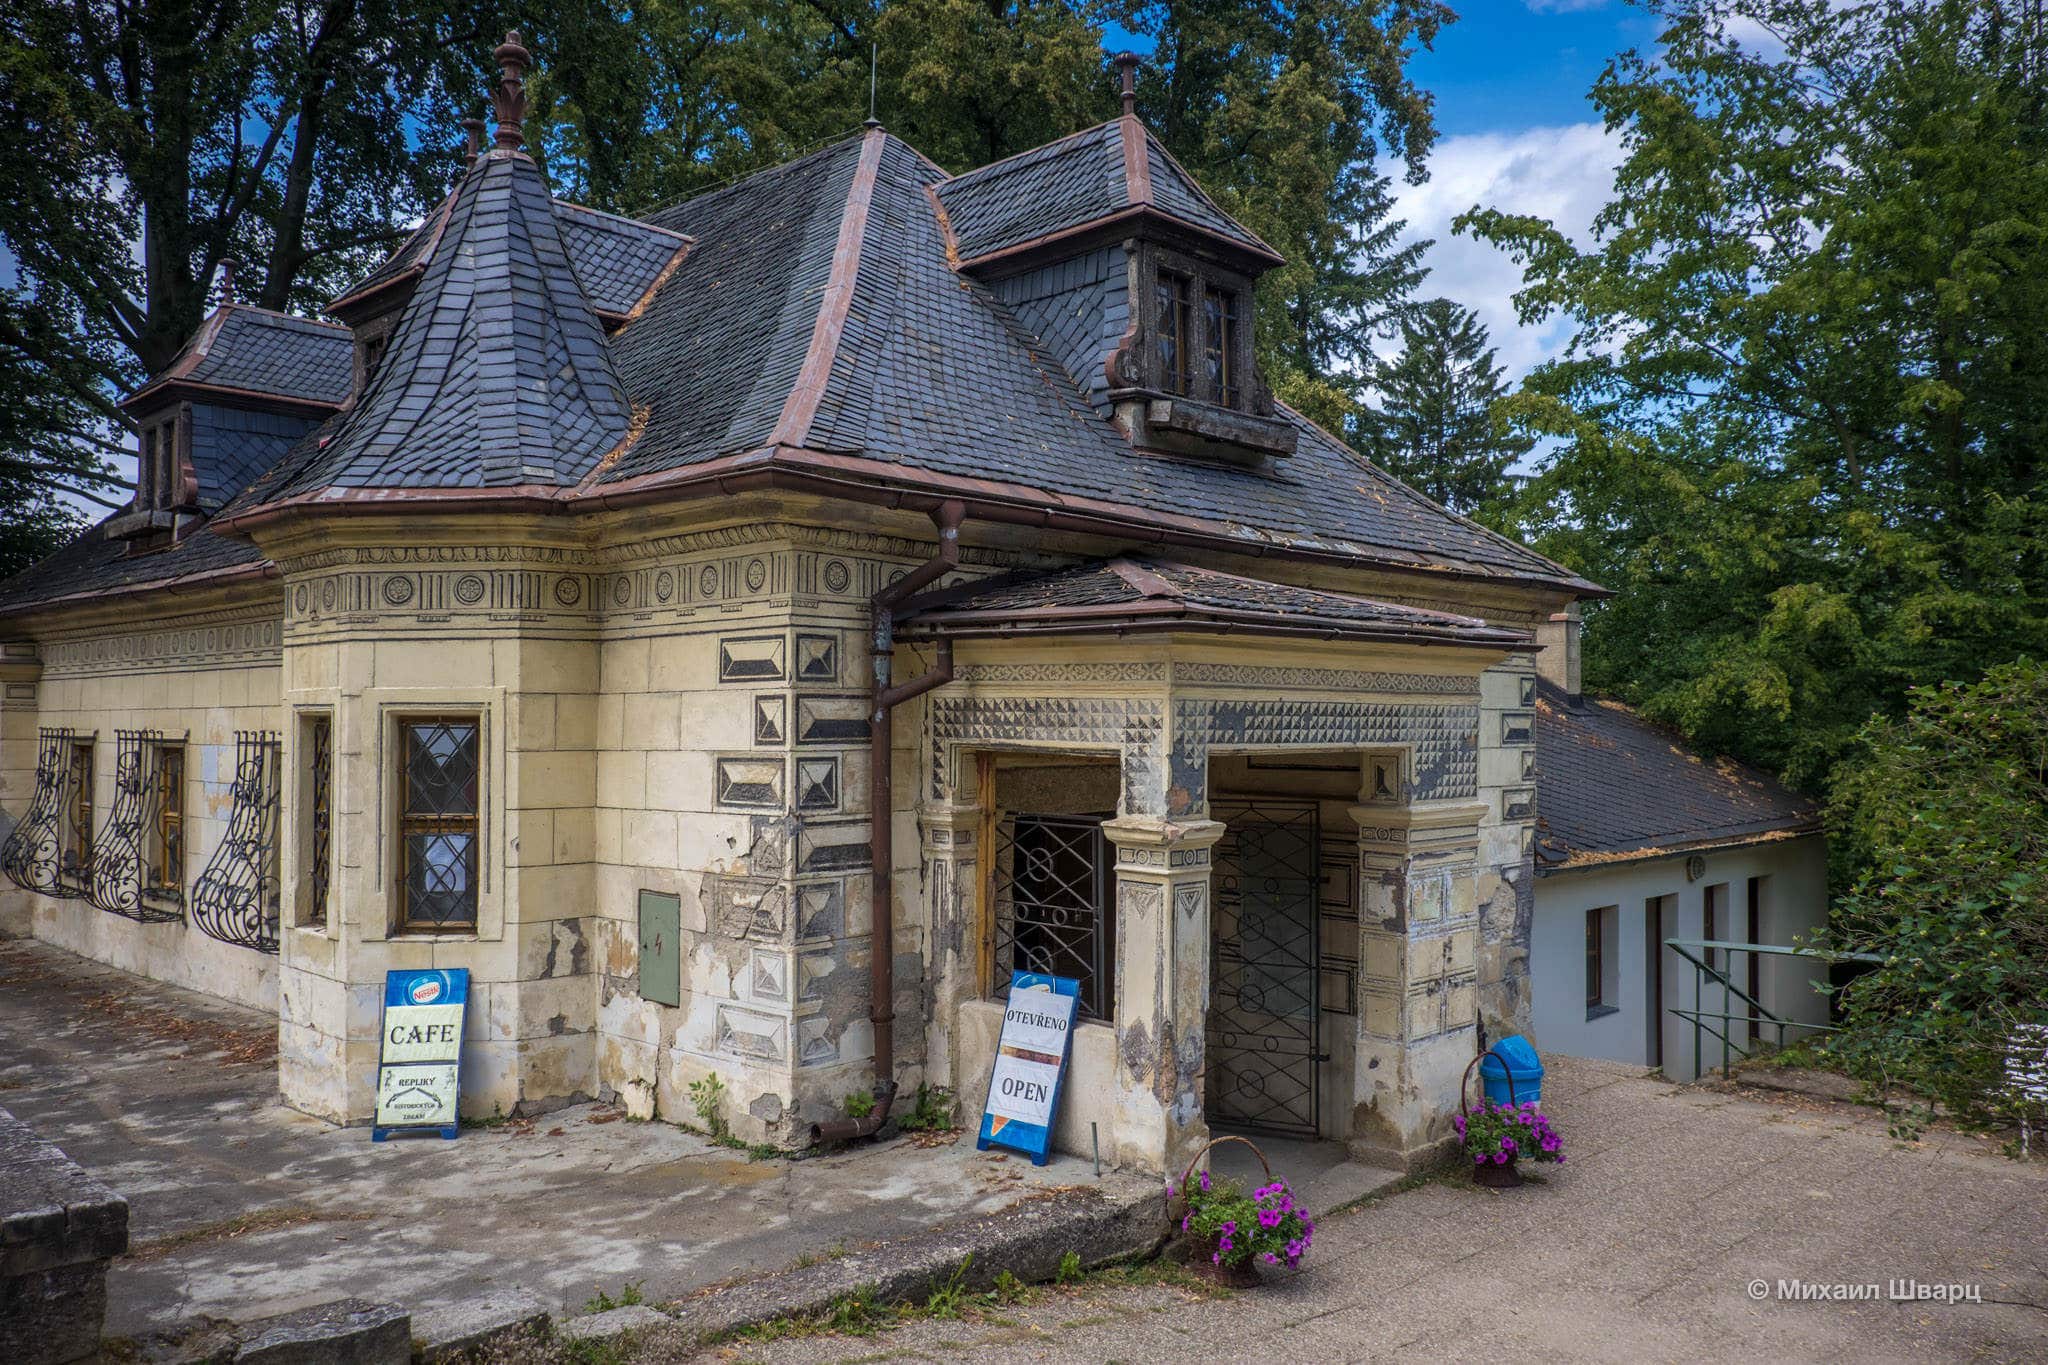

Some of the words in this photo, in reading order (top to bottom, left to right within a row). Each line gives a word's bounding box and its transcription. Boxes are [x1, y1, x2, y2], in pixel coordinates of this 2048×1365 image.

[1007, 1010, 1067, 1031] OTEVŘENO
[390, 1024, 455, 1045] CAFE
[1002, 1077, 1048, 1103] OPEN
